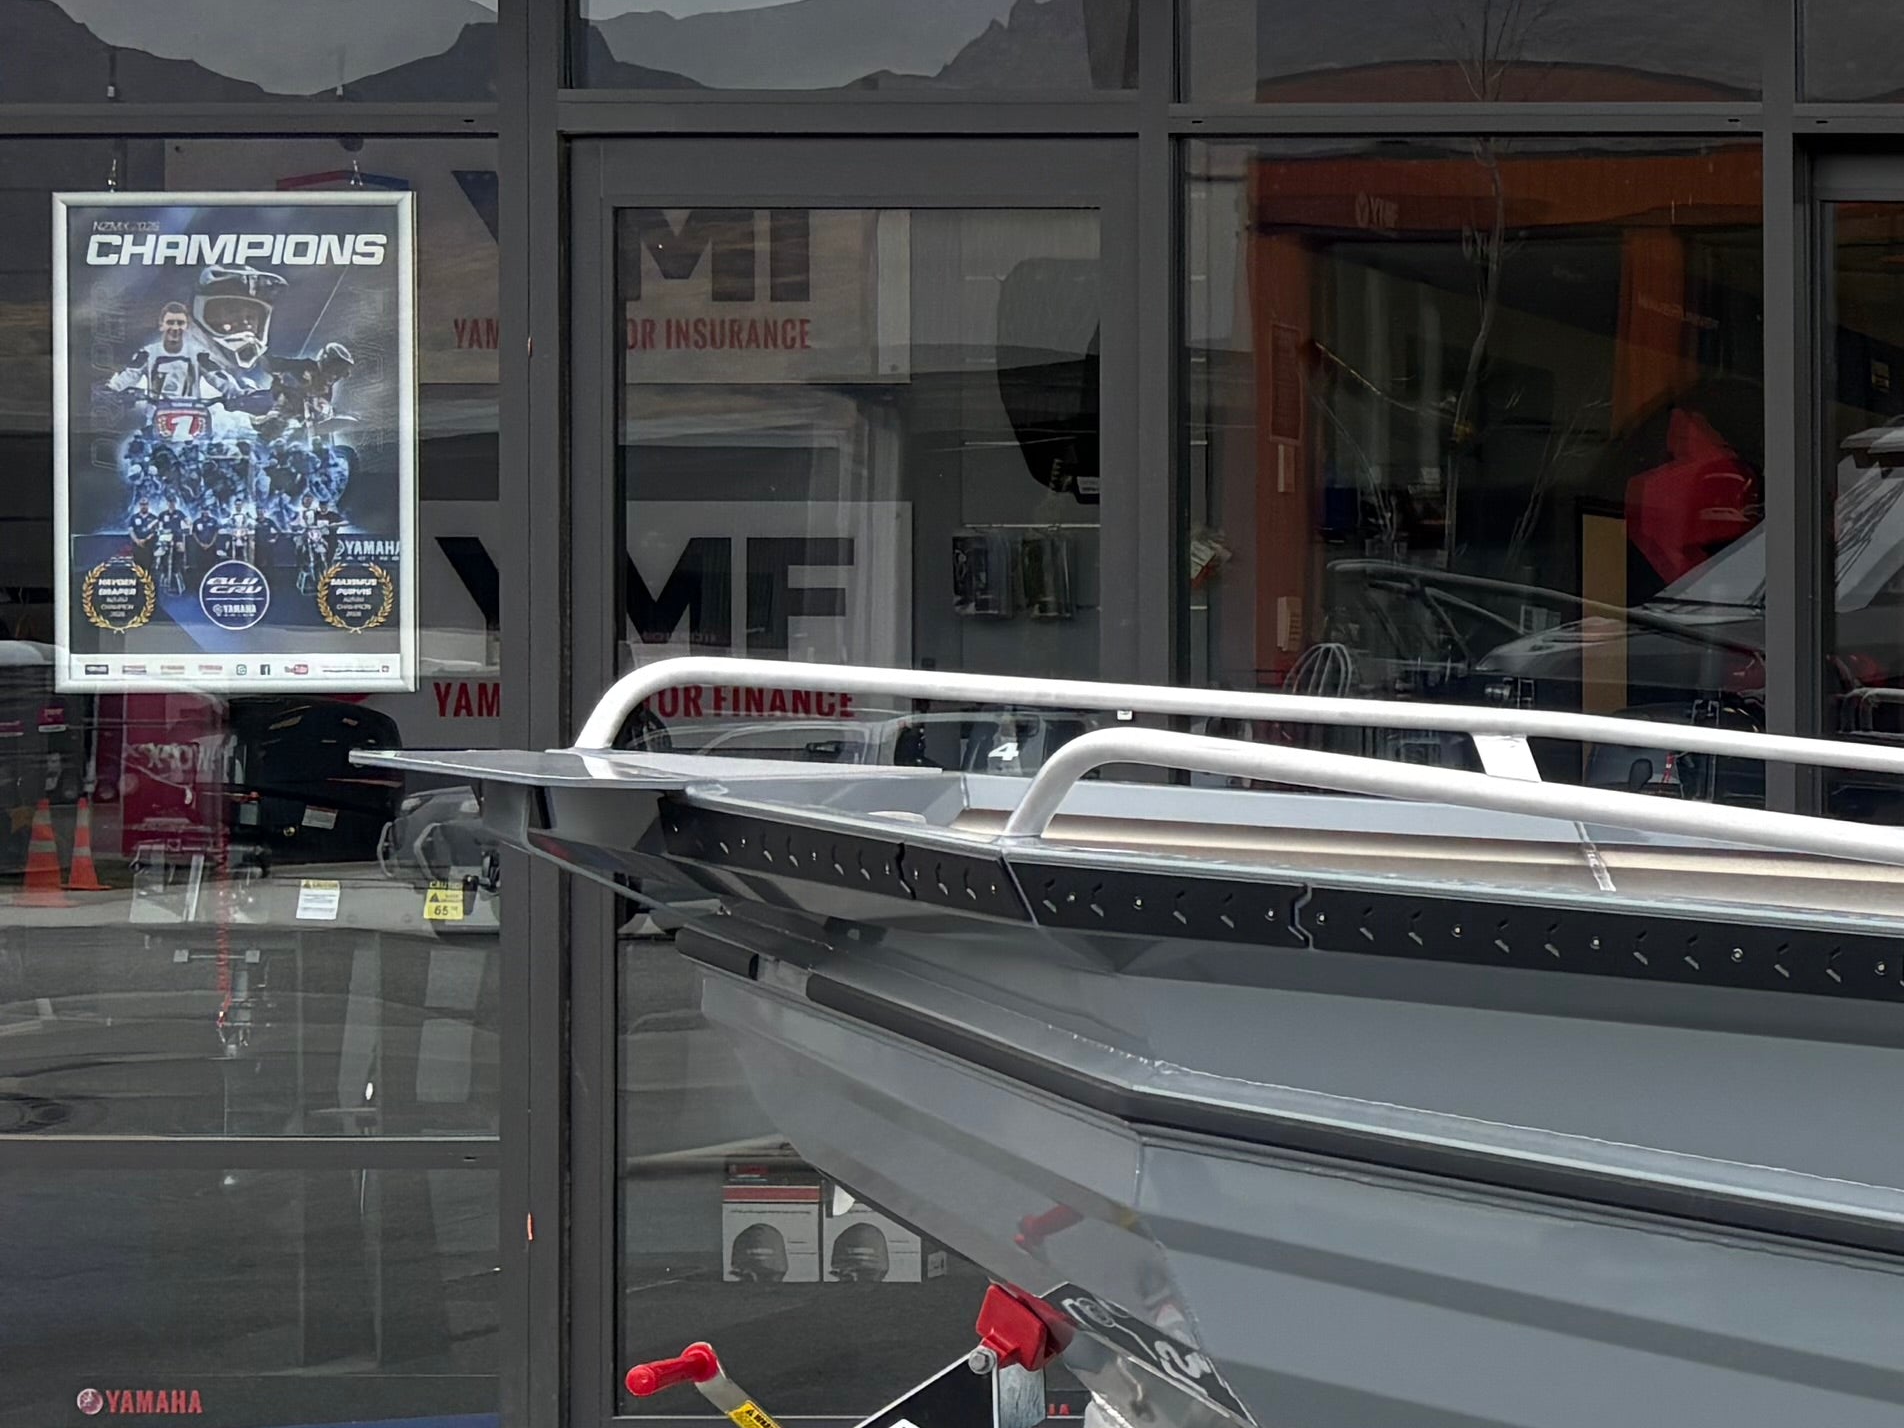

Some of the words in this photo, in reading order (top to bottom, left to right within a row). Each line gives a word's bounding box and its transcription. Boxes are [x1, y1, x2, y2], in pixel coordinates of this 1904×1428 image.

[86, 234, 387, 266] CHAMPIONS
[665, 318, 812, 350] INSURANCE
[713, 685, 856, 718] FINANCE
[105, 1389, 203, 1415] YAMAHA
